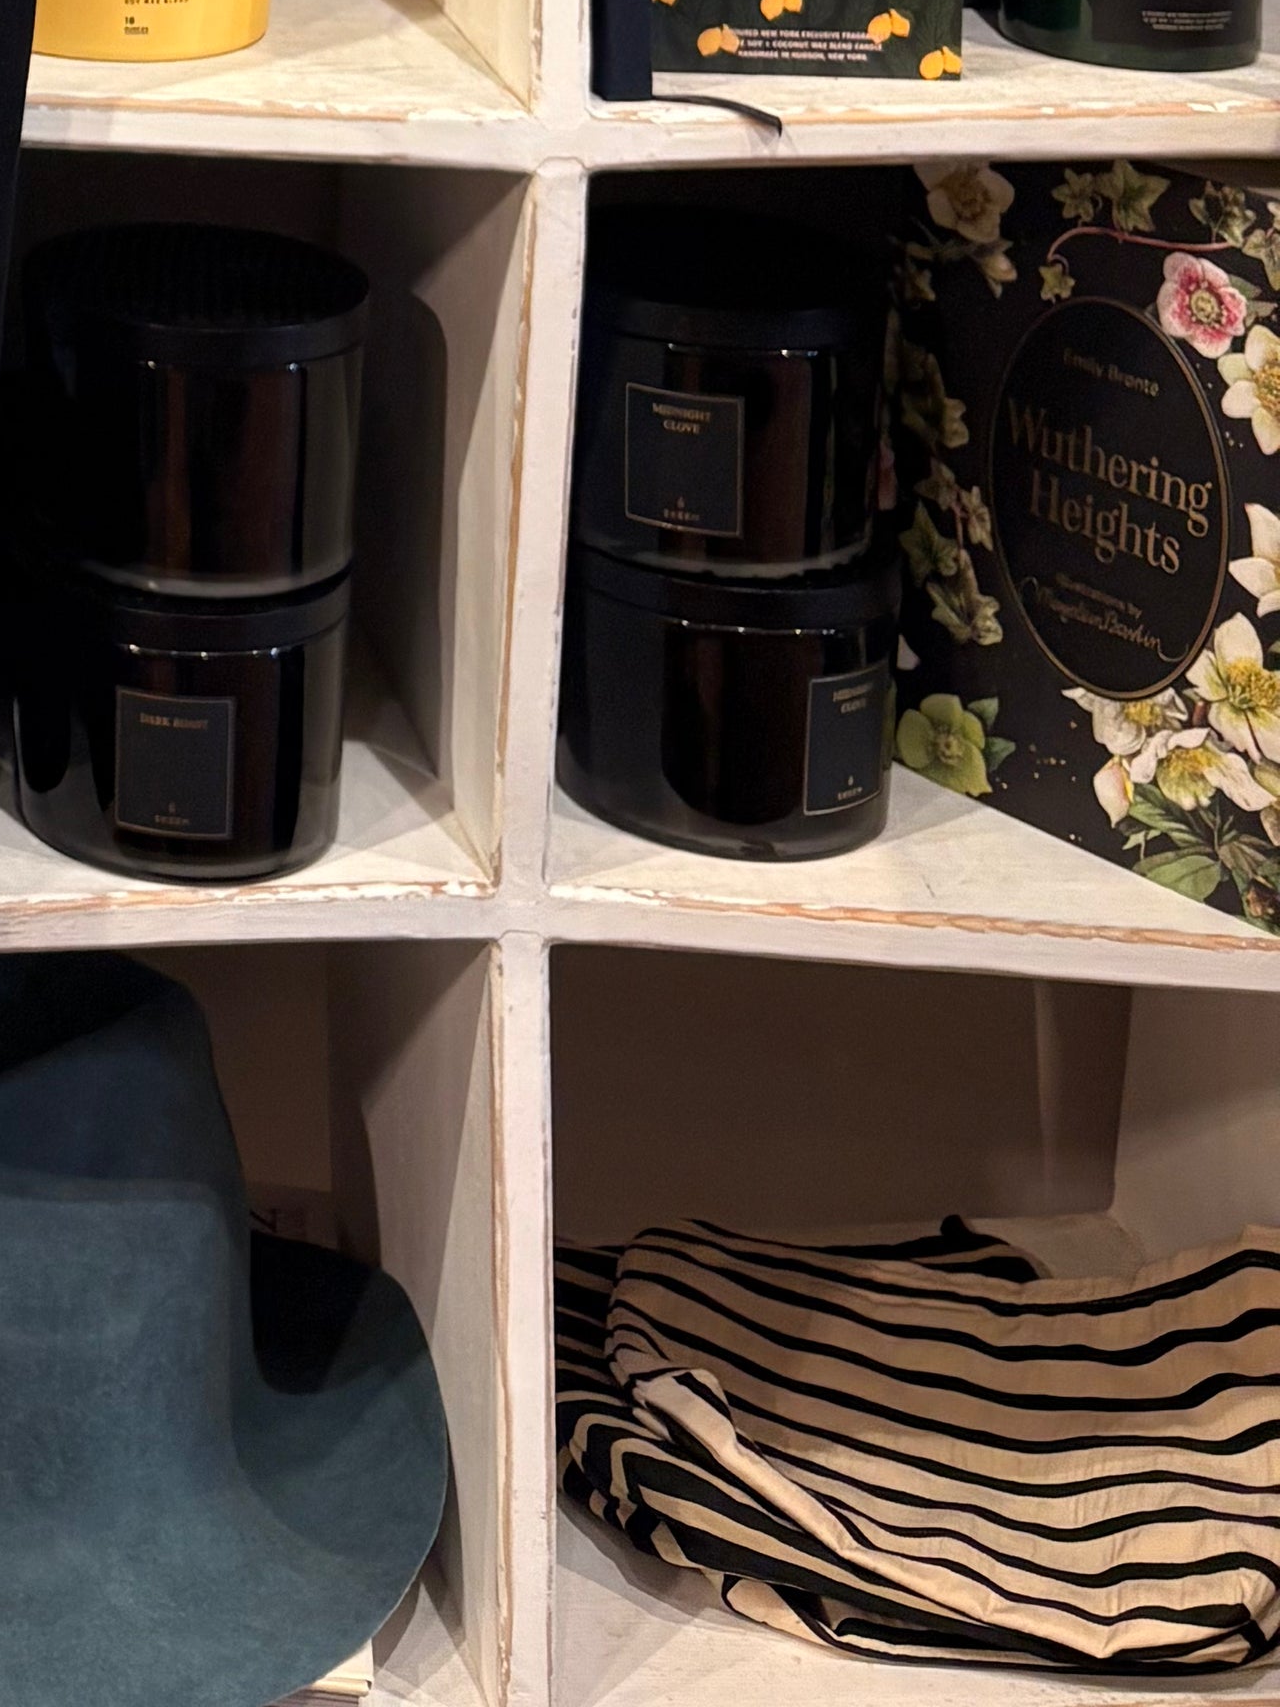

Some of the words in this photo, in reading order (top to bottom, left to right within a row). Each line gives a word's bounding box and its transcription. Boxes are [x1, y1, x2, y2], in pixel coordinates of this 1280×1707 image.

[651, 402, 711, 424] MIDNIGHT
[663, 419, 701, 435] CLOVE
[1007, 395, 1213, 538] Wuthering
[1031, 467, 1181, 575] Heights
